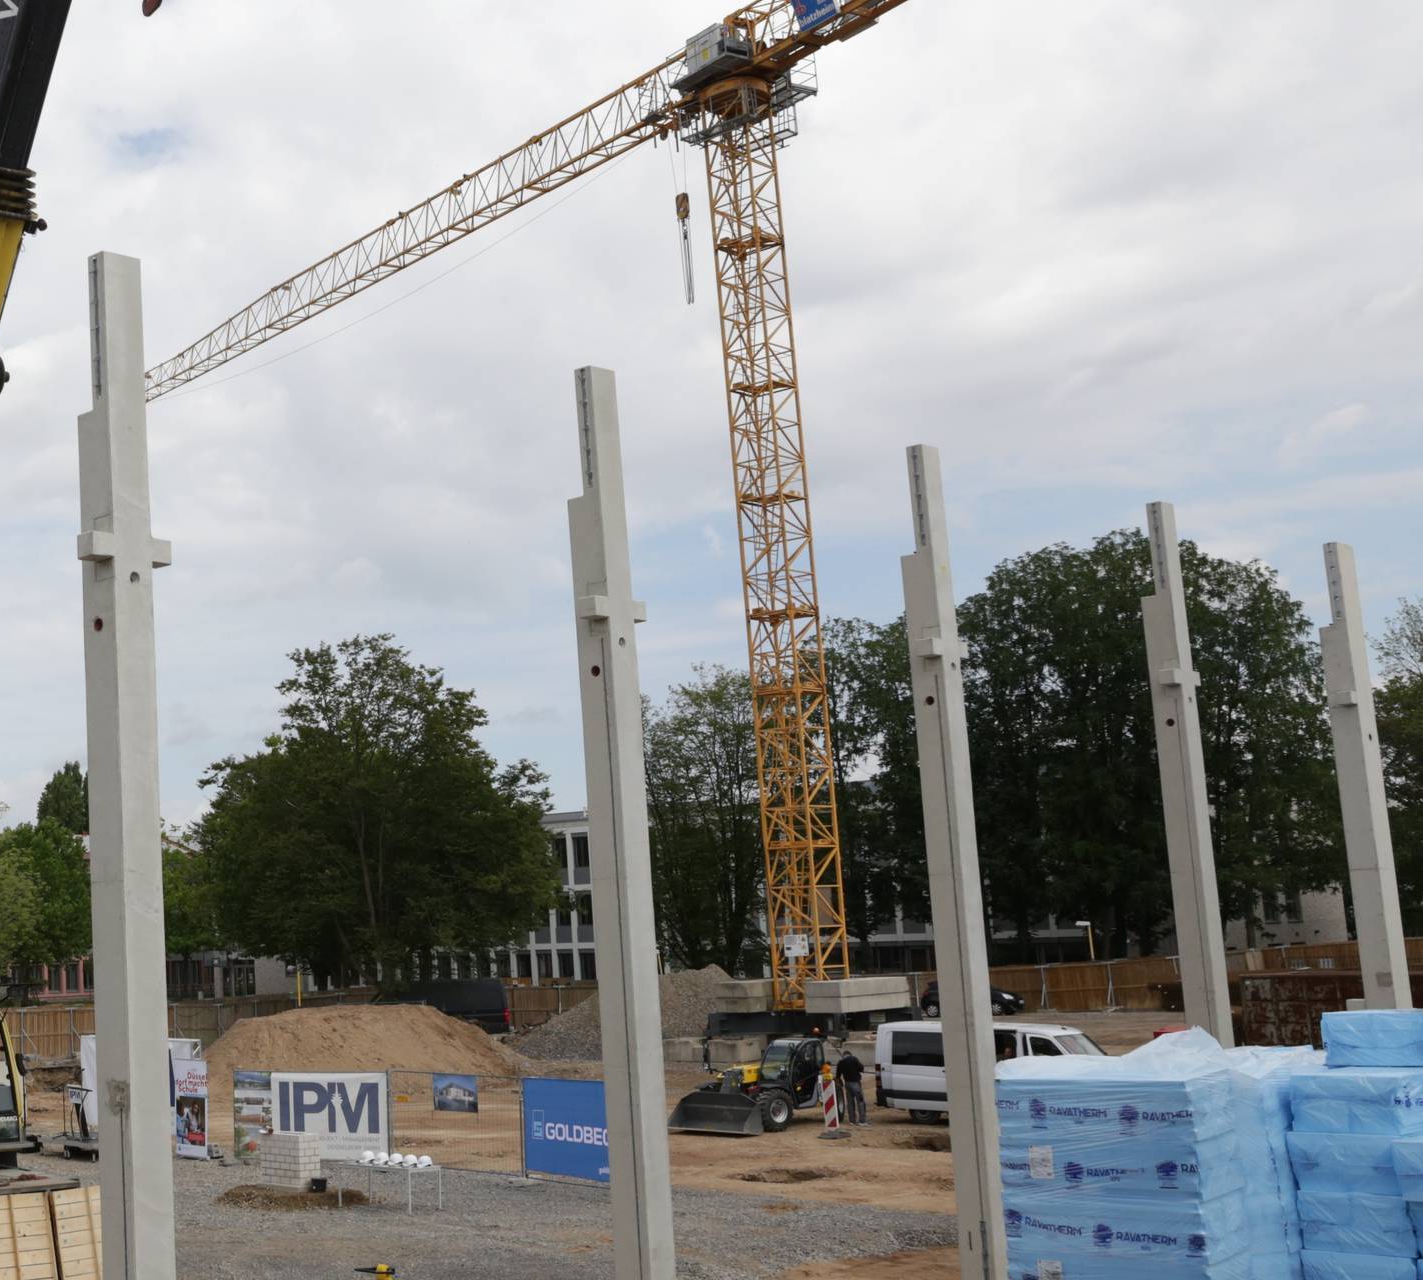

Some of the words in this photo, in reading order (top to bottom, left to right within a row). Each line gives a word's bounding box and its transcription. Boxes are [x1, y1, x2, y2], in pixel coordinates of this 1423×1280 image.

[279, 1081, 380, 1134] IPM
[1049, 1106, 1108, 1118] RAVATHERM
[1142, 1110, 1193, 1121] RAVATHER
[545, 1122, 609, 1146] GOLDBEC
[1025, 1216, 1082, 1236] RAVATHERM
[1116, 1231, 1177, 1246] RAVATHERM
